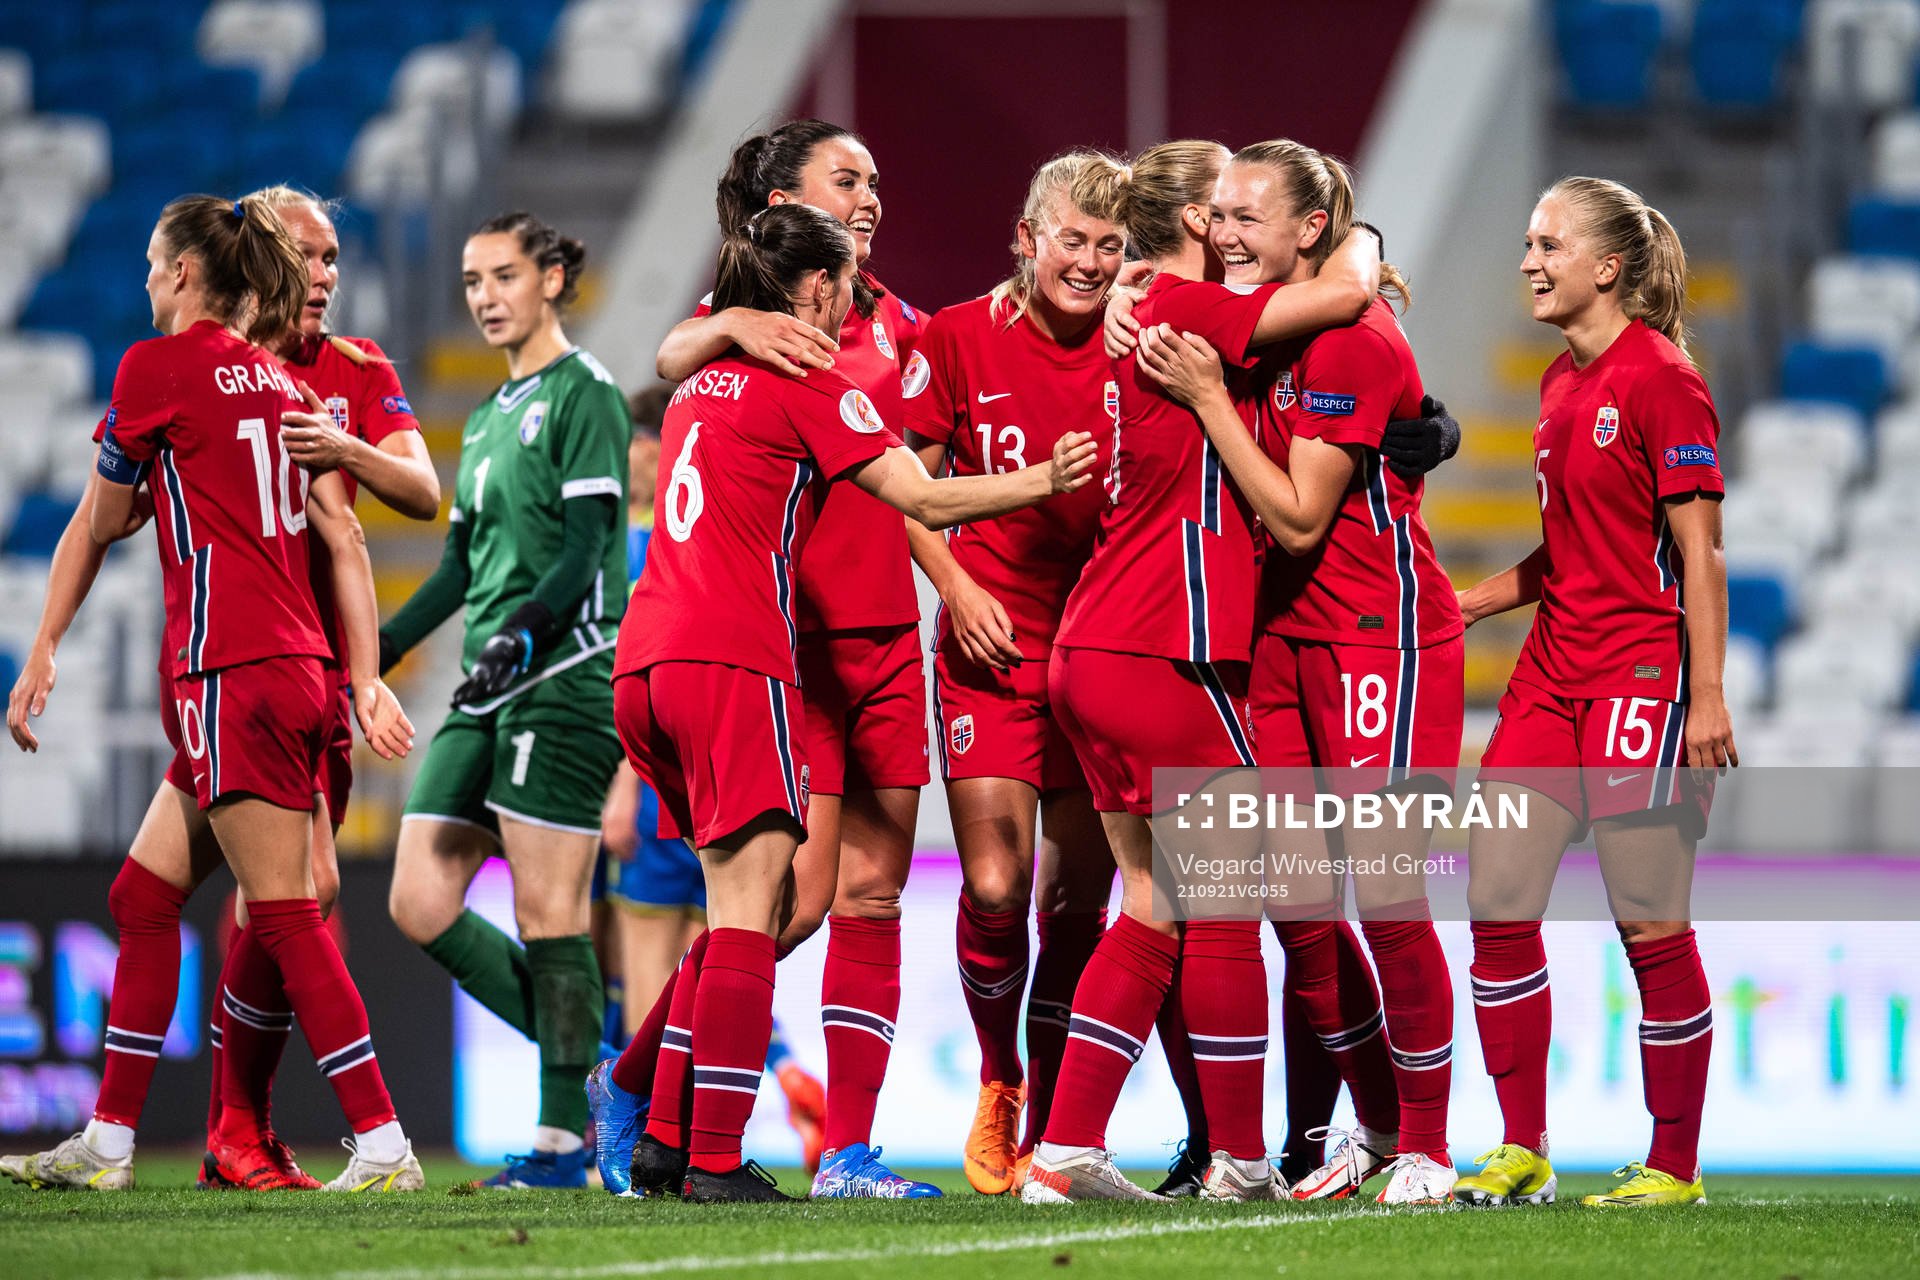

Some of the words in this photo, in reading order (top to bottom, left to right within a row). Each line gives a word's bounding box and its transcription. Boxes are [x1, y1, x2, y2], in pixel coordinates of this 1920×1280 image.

[669, 369, 749, 407] HANSEN
[1312, 398, 1355, 410] RESPECT
[236, 418, 310, 537] 10
[976, 423, 1027, 476] 13
[1679, 449, 1715, 463] RESPECT
[473, 456, 491, 513] 1
[665, 421, 704, 543] 6
[1340, 673, 1388, 738] 18
[1605, 697, 1659, 760] 15
[511, 729, 536, 786] 1
